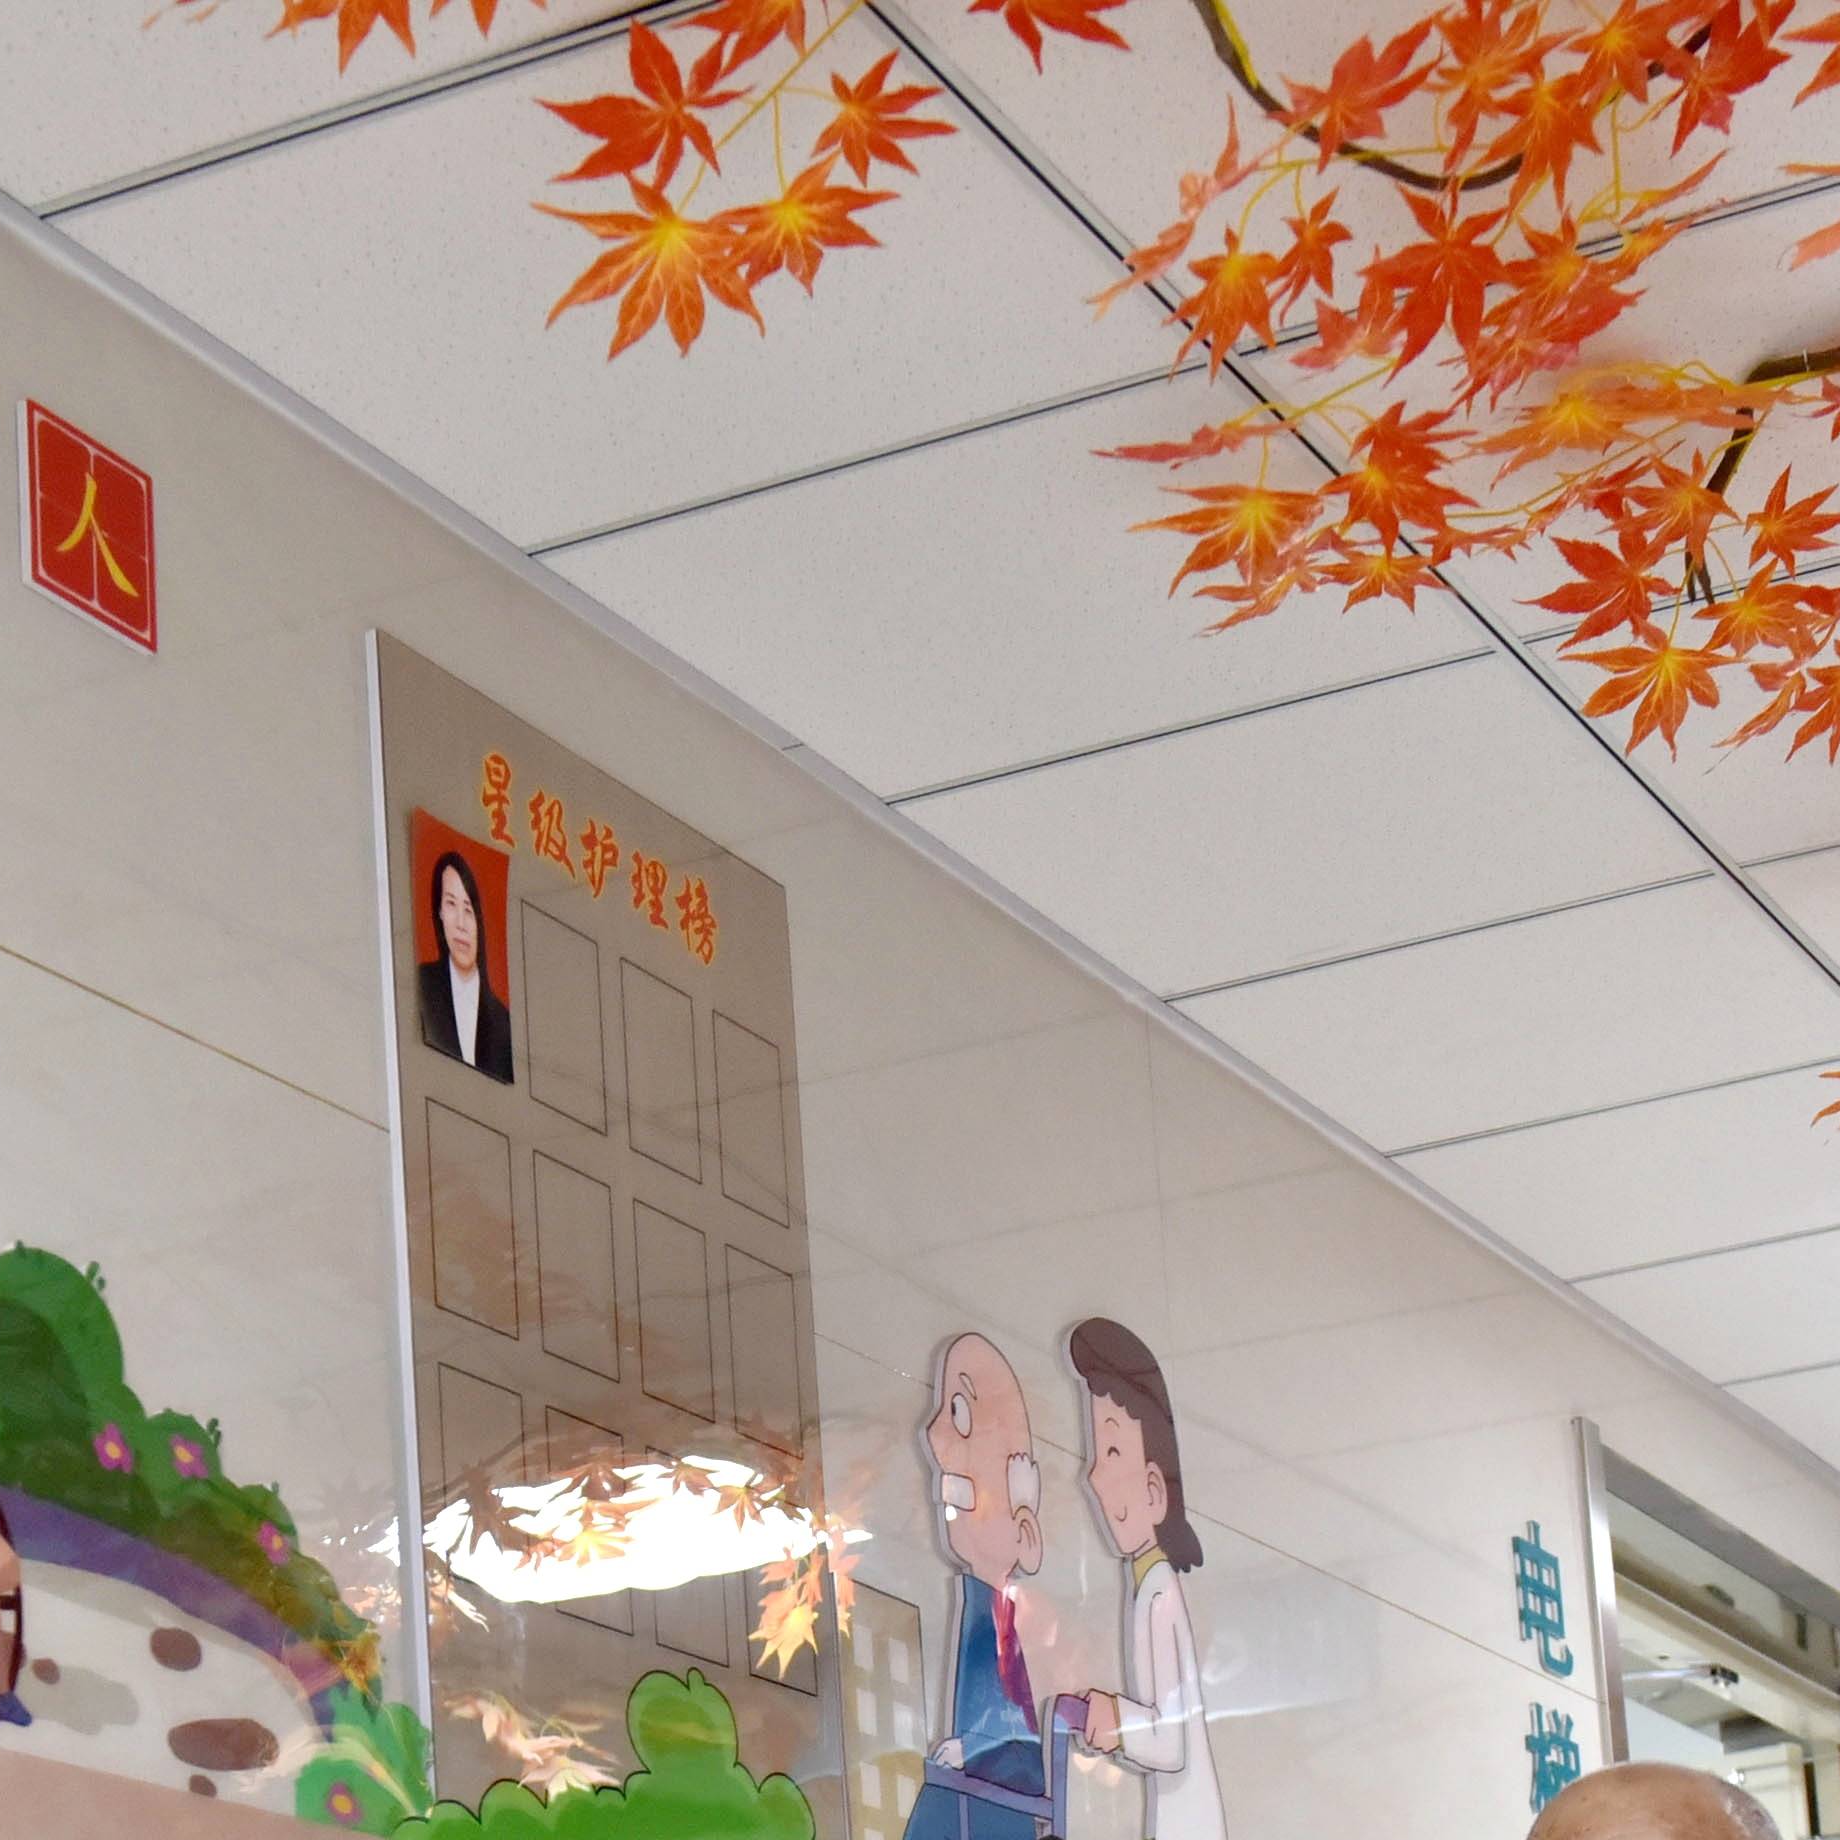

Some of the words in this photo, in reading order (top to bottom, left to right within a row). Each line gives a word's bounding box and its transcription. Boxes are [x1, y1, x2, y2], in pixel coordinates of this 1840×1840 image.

[481, 752, 718, 966] 星级护理榜
[1512, 1521, 1581, 1814] 电梯
